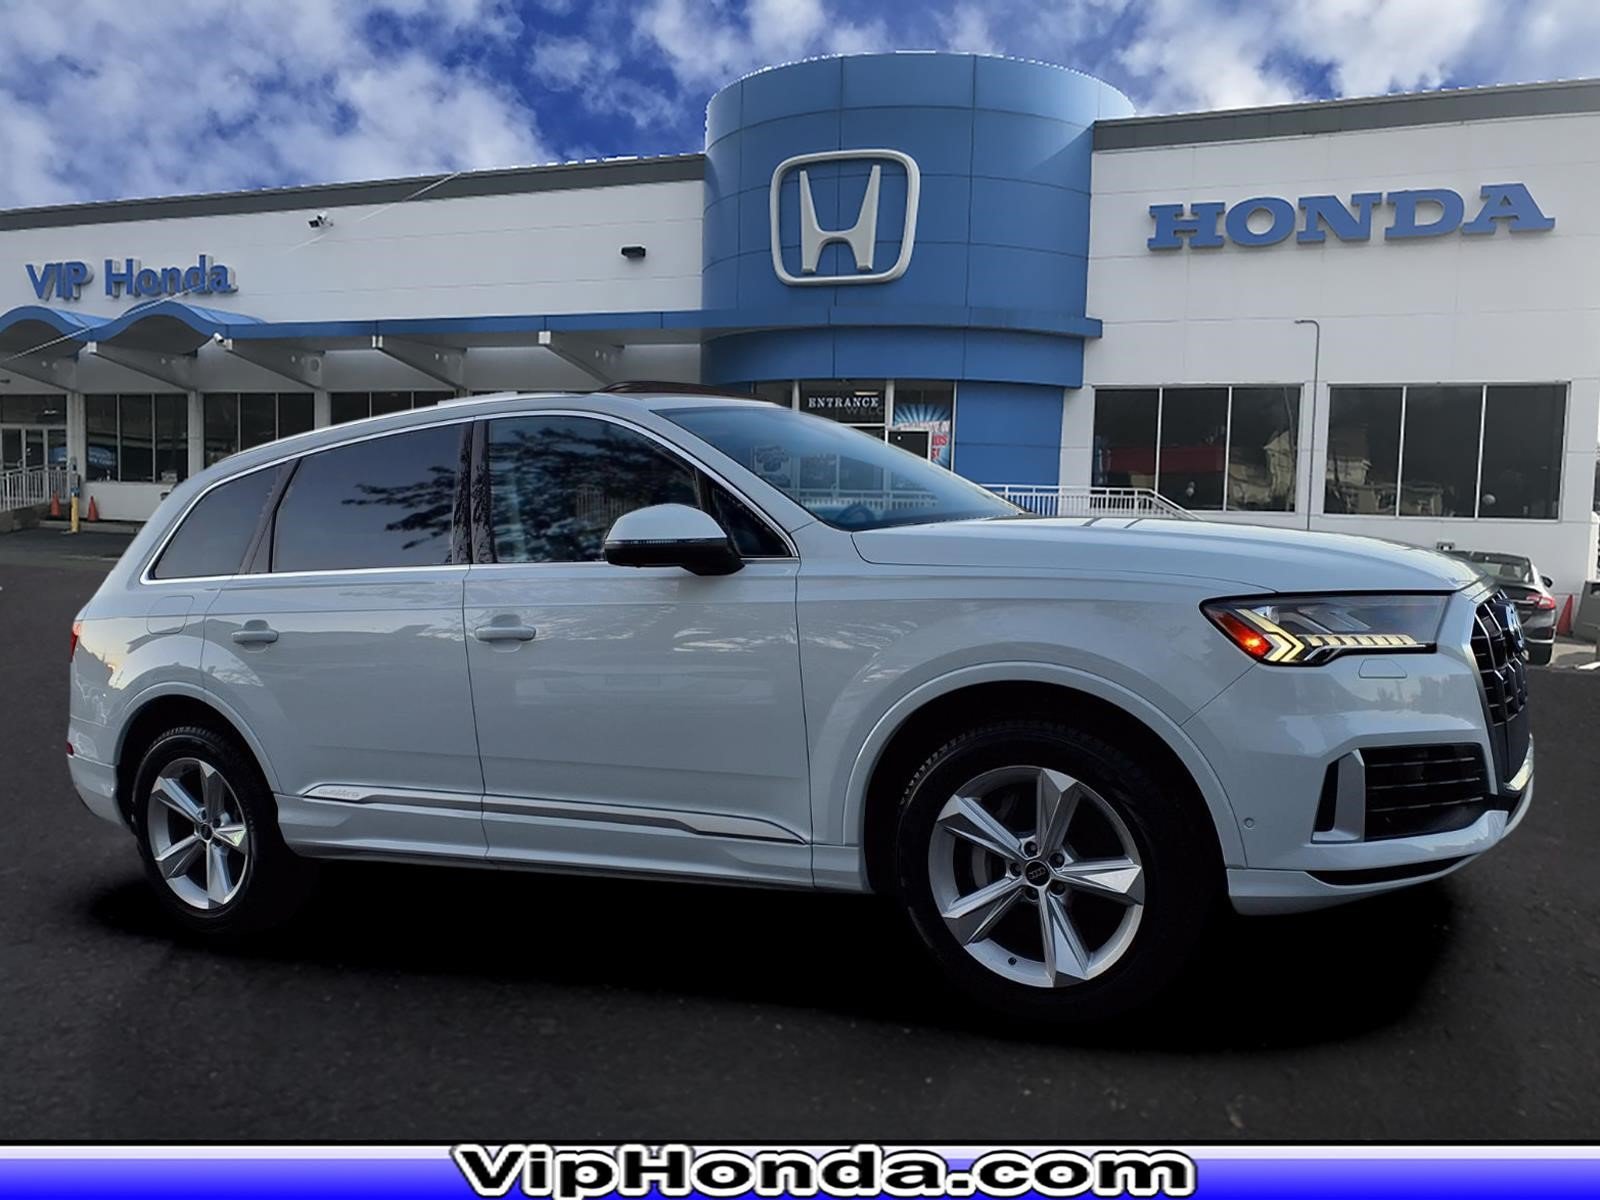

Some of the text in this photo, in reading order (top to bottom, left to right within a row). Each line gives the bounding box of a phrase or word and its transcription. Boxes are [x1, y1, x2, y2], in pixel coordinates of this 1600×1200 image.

[1147, 182, 1556, 251] HONDA
[25, 254, 238, 301] VIP Honda
[808, 396, 880, 408] ENTRANCE
